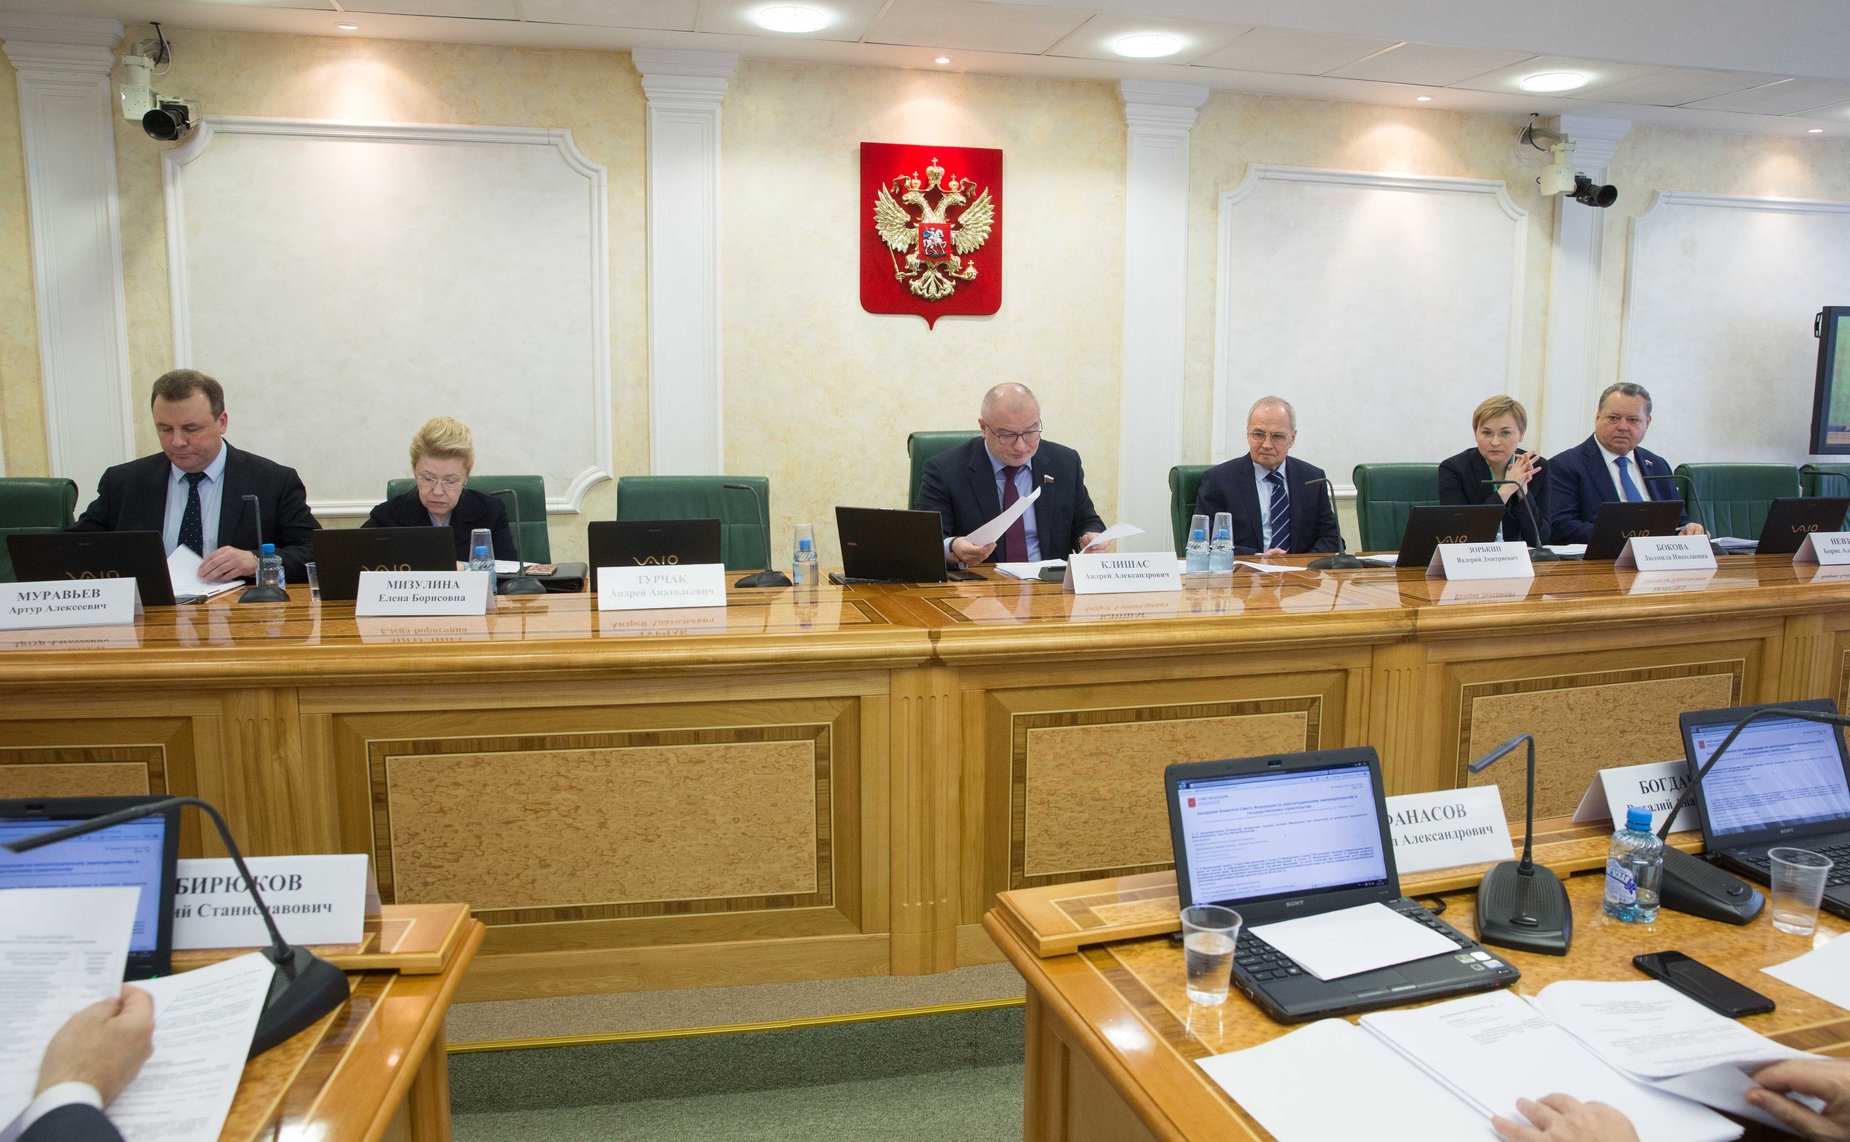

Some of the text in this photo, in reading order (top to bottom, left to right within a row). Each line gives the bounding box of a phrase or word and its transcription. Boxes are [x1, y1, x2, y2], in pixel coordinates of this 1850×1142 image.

[1656, 543, 1689, 552] БОКОВА
[632, 554, 679, 566] VAIO
[1101, 560, 1151, 569] КЛИШАС
[386, 580, 460, 590] МИЗУЛИНА
[636, 574, 688, 585] ТУРЧАК
[17, 588, 101, 602] МУРАВЬЕВ
[378, 593, 466, 604] Елена Борисовна
[9, 603, 107, 616] Артур Алексеевич
[1402, 825, 1494, 846] Александрович
[175, 874, 302, 896] БИРЮКОВ
